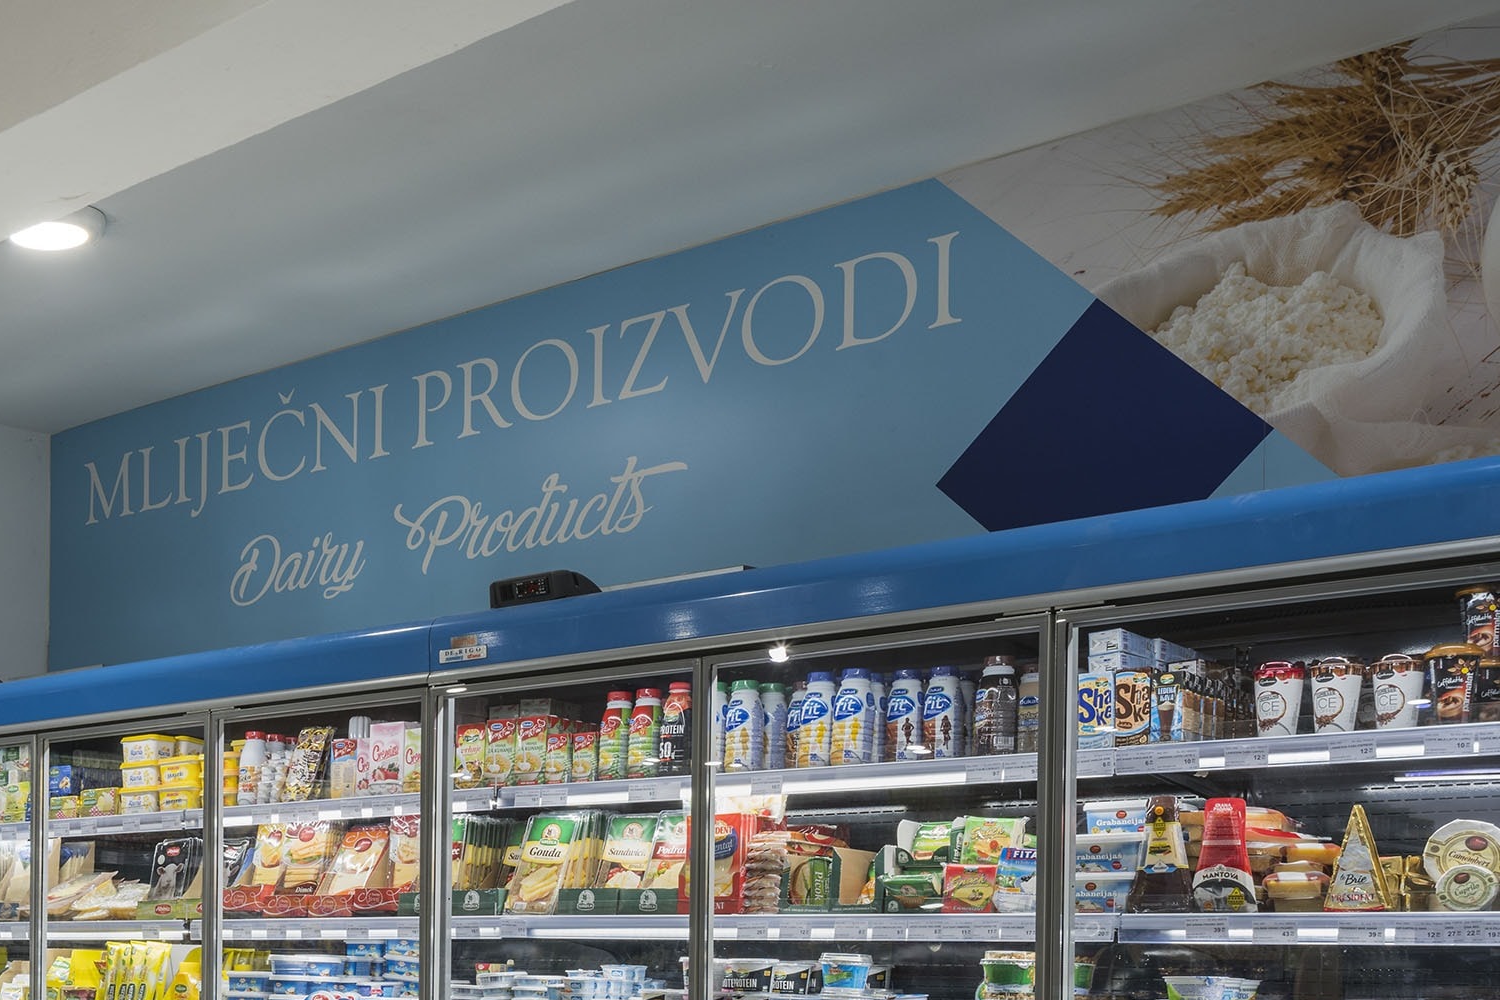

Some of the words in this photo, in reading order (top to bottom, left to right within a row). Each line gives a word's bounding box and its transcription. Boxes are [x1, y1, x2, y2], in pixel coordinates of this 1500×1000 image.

[84, 386, 392, 526] MLIJEČNI
[411, 230, 962, 451] PROIZVODI
[230, 532, 367, 607] Dairy
[394, 455, 688, 575] Products
[801, 700, 820, 719] fit
[835, 696, 855, 714] fit
[529, 847, 561, 858] Gouda
[1448, 850, 1491, 867] Camembert
[1202, 872, 1239, 880] MANTOVA
[1345, 873, 1367, 885] Brie
